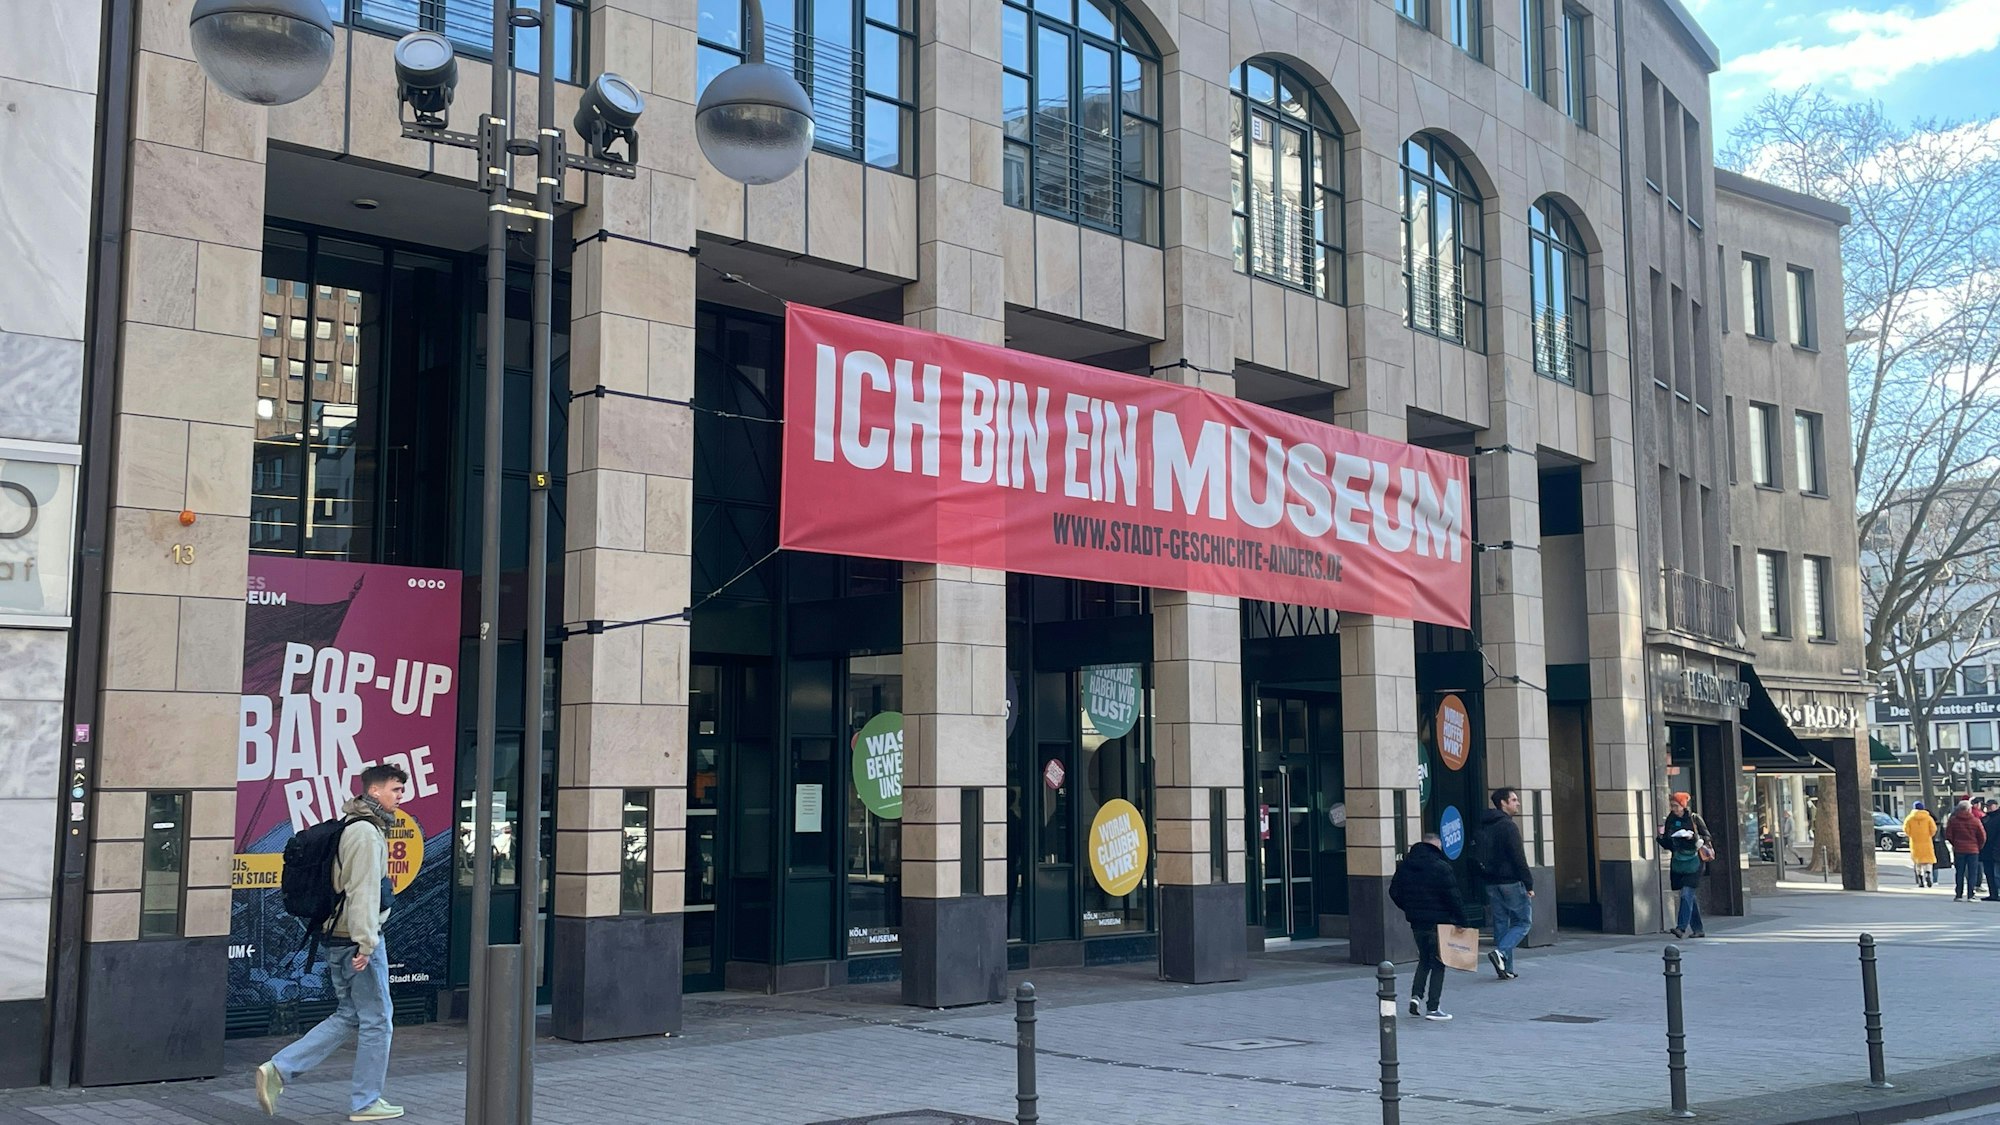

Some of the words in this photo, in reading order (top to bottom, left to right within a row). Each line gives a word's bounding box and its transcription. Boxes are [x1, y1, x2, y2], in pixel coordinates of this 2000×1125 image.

[814, 343, 941, 477] ICH
[961, 371, 1049, 493] BIN
[1064, 392, 1139, 507] EIN
[1153, 409, 1462, 563] MUSEUM
[537, 474, 545, 487] 5
[172, 543, 195, 565] 13
[1053, 512, 1343, 582] WWW.STADT-GESCHICHTE-ANDERS.DE
[245, 591, 287, 606] EUM
[279, 641, 452, 717] POP-UP
[1089, 675, 1117, 700] HABEN
[1118, 683, 1136, 706] WIR
[1091, 695, 1132, 724] LUST?
[1889, 705, 1911, 717] Der
[1974, 701, 1995, 714] für
[237, 693, 367, 781] BAR
[1443, 736, 1463, 758] WIR?
[284, 745, 438, 834] RIKDE
[1098, 812, 1132, 843] WORAN
[1097, 829, 1140, 866] GLAUBEN
[246, 871, 278, 885] STAGE
[1104, 850, 1139, 881] WIR?
[389, 974, 411, 984] Stadt
[411, 972, 430, 982] Köln
